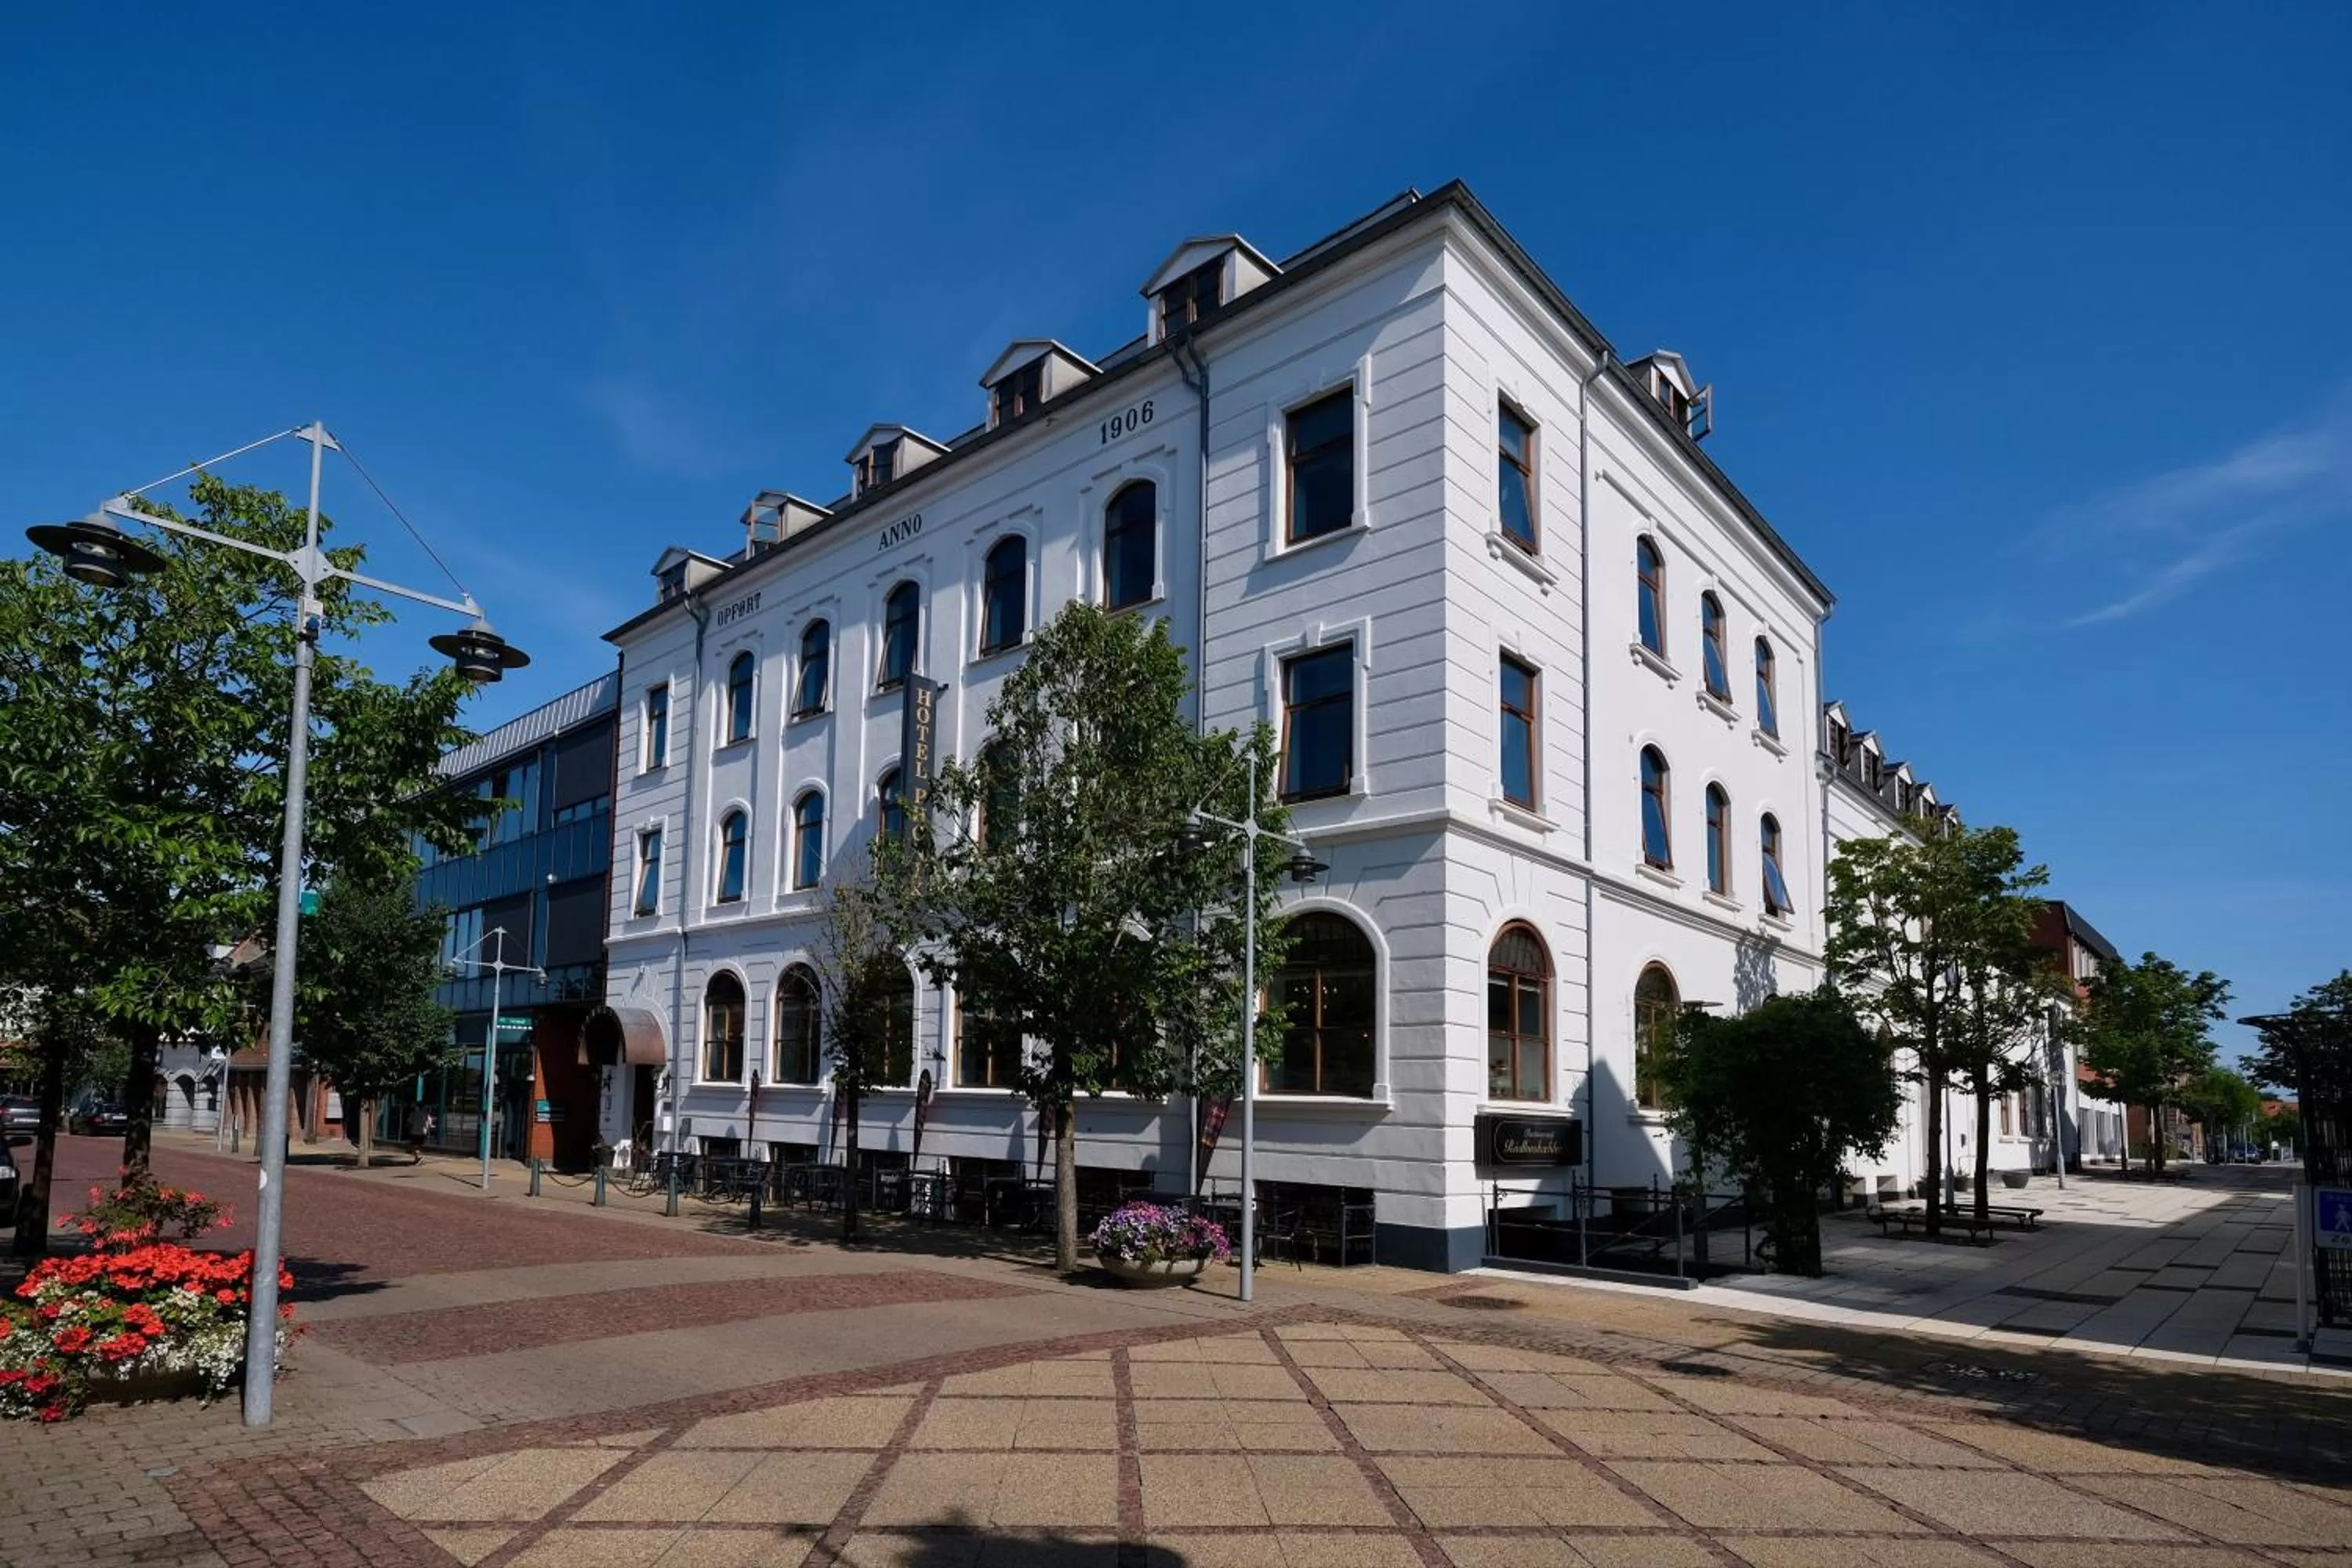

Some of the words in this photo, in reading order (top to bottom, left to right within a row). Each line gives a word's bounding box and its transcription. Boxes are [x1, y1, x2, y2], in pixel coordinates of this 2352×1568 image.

[878, 514, 922, 551] ANNO
[1101, 401, 1154, 445] 1906
[916, 688, 931, 779] HOTEL
